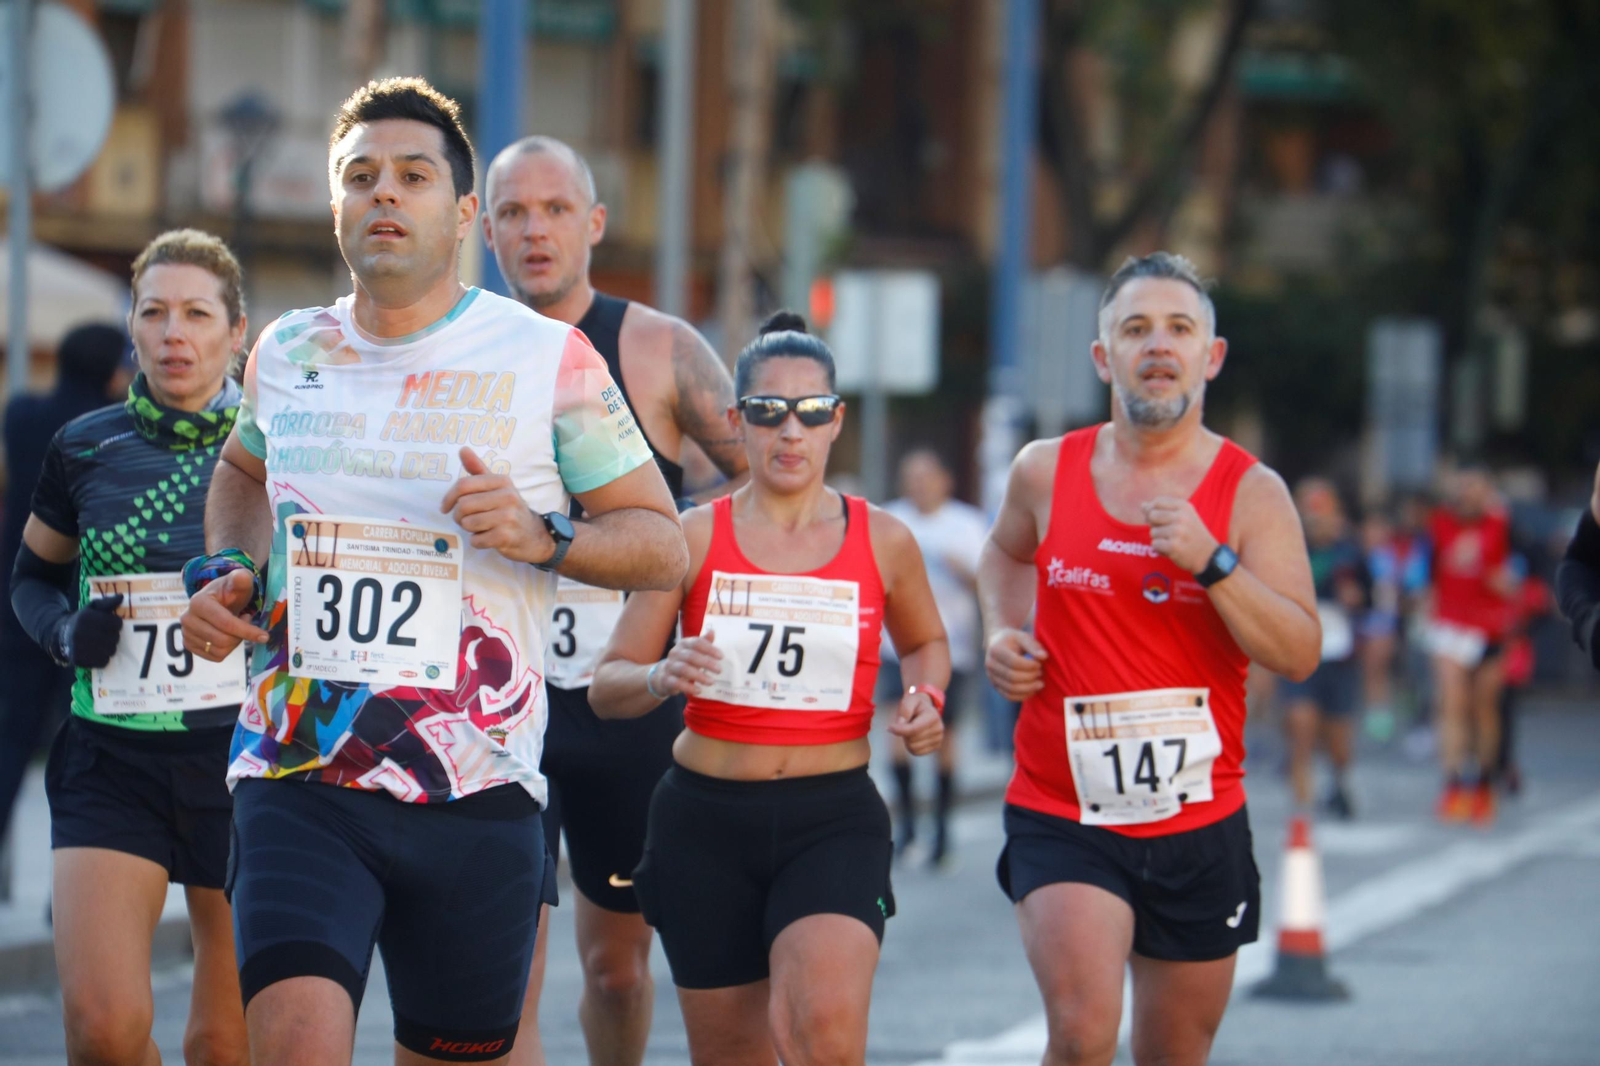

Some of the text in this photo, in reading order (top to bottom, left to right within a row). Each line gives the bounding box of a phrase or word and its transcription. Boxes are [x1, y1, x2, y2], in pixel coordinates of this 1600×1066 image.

[395, 370, 516, 413] MEDIA
[380, 405, 517, 449] MARATÓN
[268, 439, 396, 478] LMODÓVAR
[400, 451, 452, 482] DEL
[295, 520, 434, 568] XLI CARRERA POPULAR
[346, 543, 380, 552] SANTISIMA
[382, 545, 411, 555] TRINIDAD
[416, 549, 453, 559] TRINITARIOS
[339, 558, 454, 577] MEMORIAL "ADOLFO RIVERA"
[1054, 566, 1111, 589] califas
[316, 574, 422, 647] 302
[708, 578, 753, 616] XLI
[133, 623, 194, 679] 79
[552, 607, 577, 658] 3
[747, 623, 806, 677] 75
[1103, 738, 1187, 795] 147
[429, 1037, 506, 1054] HOKO
